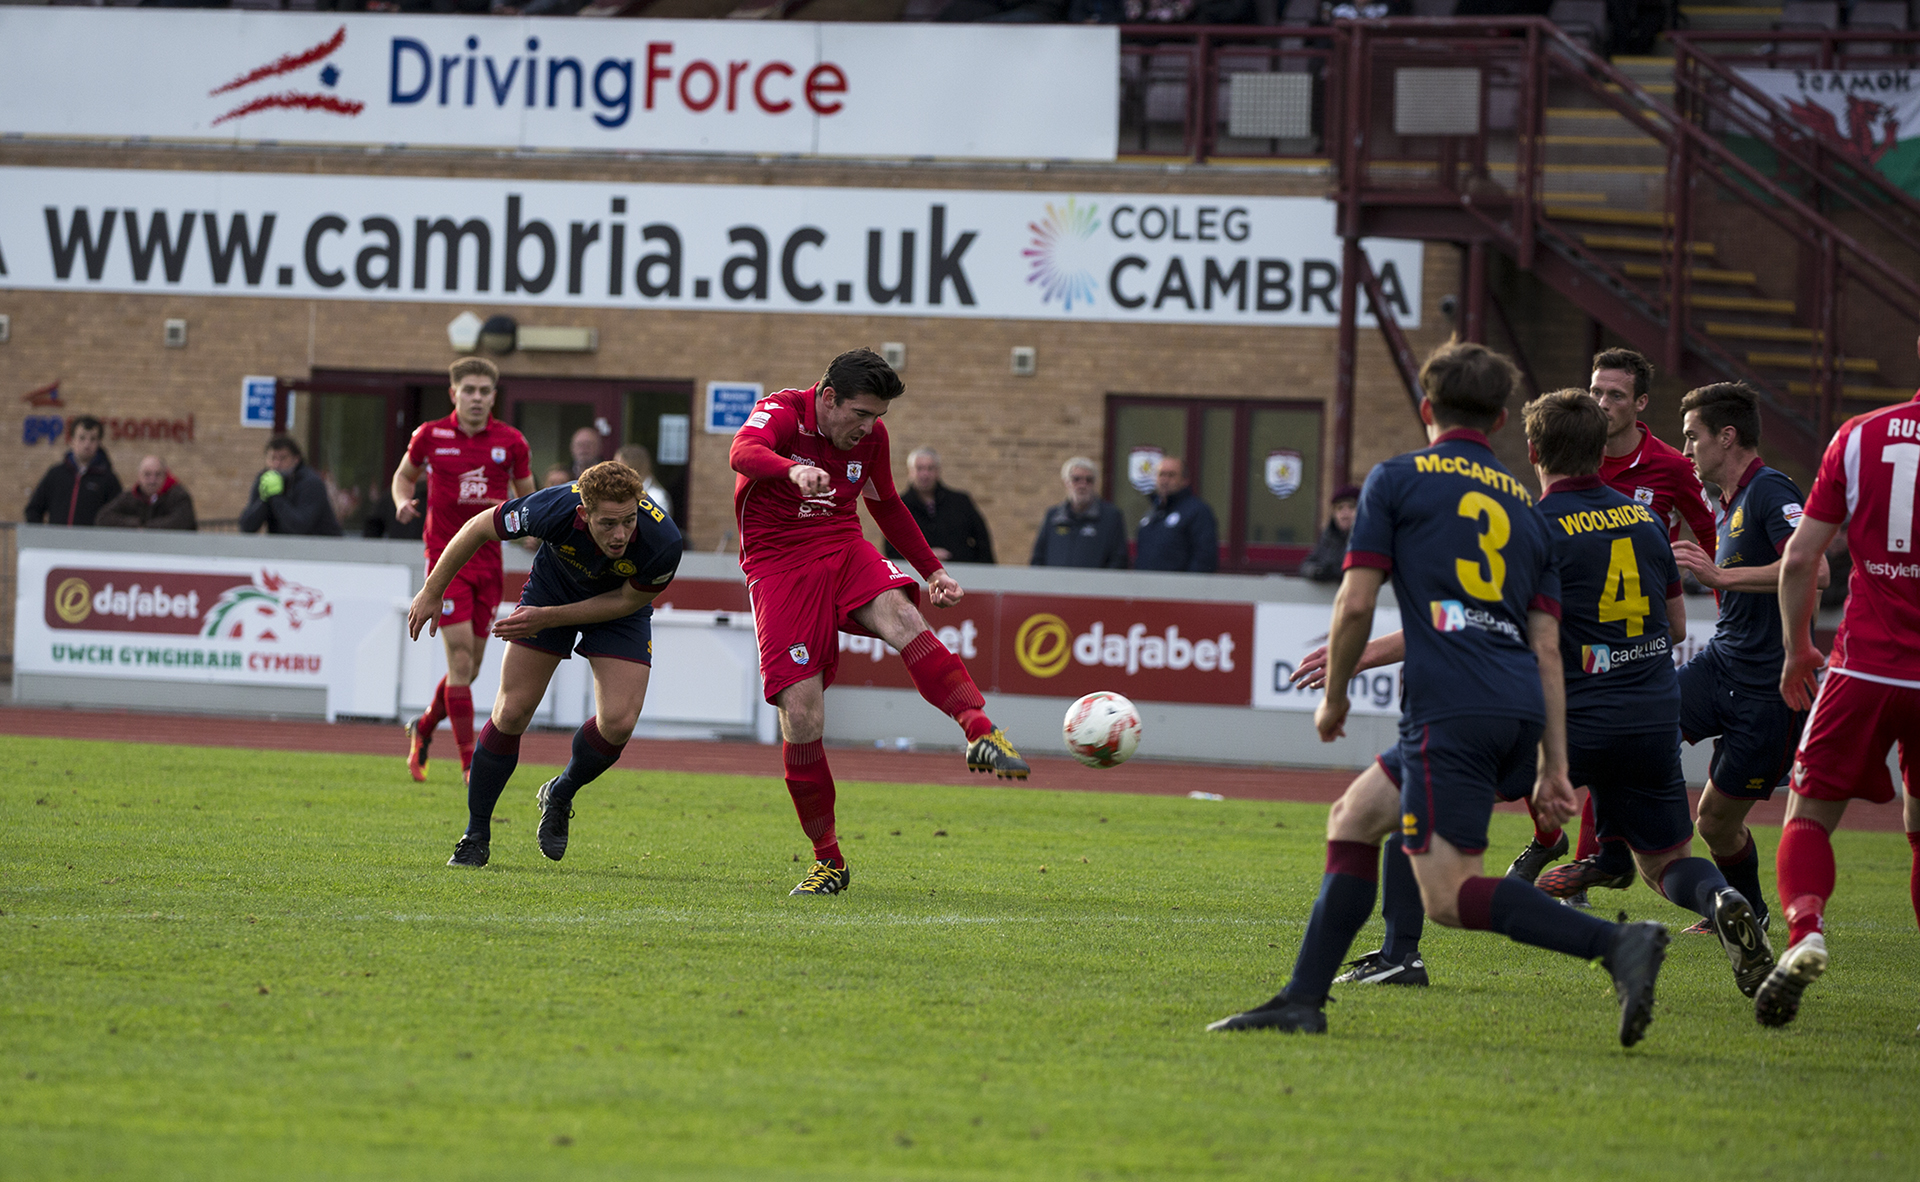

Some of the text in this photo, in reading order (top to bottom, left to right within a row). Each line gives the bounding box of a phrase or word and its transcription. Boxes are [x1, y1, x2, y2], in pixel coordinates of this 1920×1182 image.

[45, 194, 979, 306] www.cambria.ac.uk
[1110, 205, 1251, 242] COLEG
[1108, 255, 1411, 315] CAMBRA
[1456, 491, 1511, 602] 3
[1558, 504, 1655, 536] WOOLRIDGE
[93, 583, 200, 622] dafabet
[1598, 537, 1650, 638] 4
[52, 643, 321, 674] UWCH GYNGHRAIR CYMRU
[1072, 621, 1236, 676] dafabet
